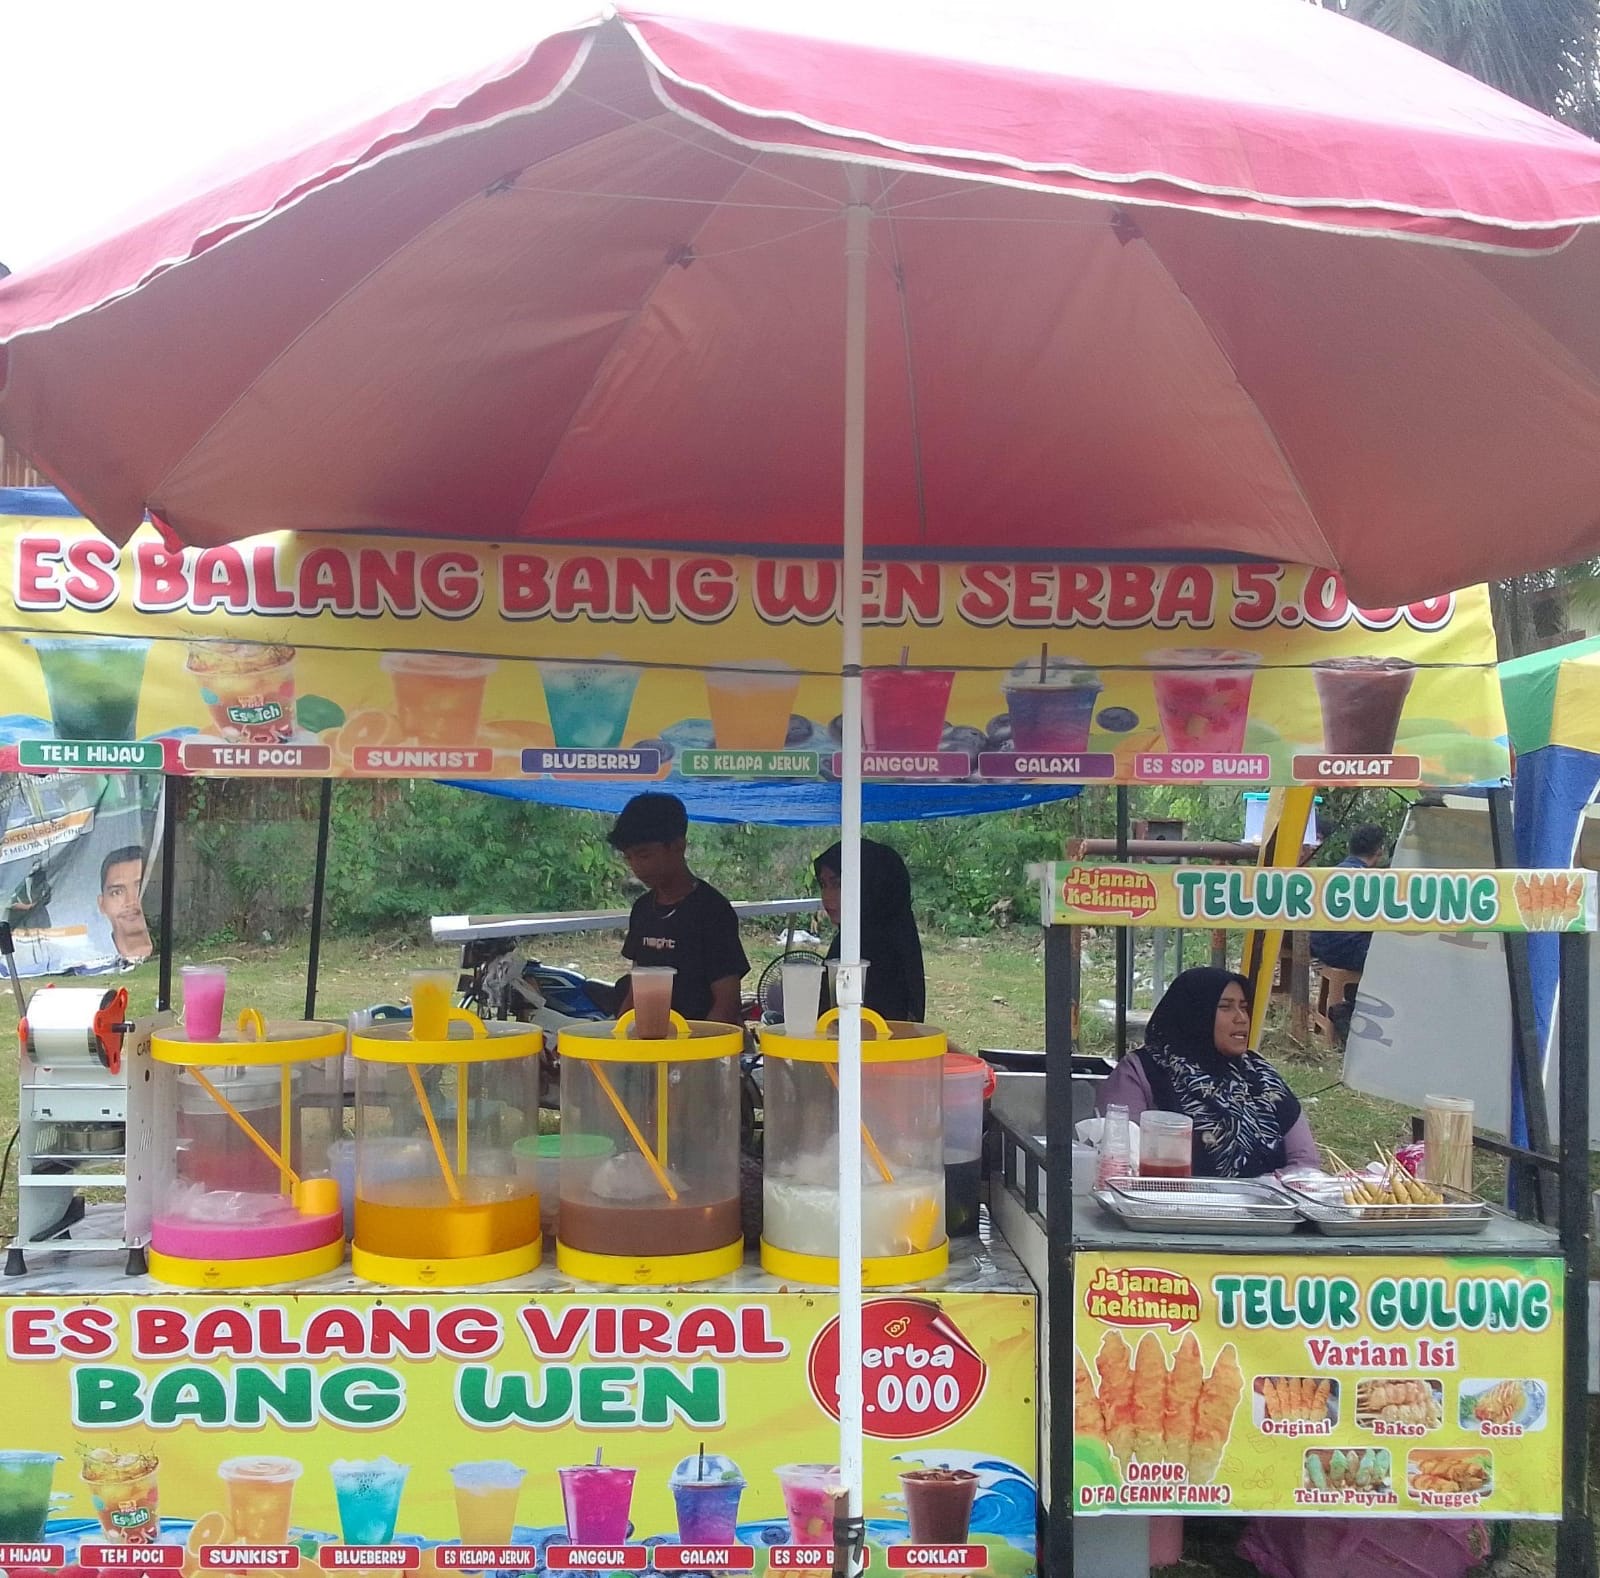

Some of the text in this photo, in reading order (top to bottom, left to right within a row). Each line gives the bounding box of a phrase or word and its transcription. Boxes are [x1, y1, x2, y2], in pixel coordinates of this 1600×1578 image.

[18, 537, 119, 607] ES
[136, 541, 484, 613] BALANG
[500, 553, 737, 620] BANG
[960, 563, 1215, 625] SERBA
[1233, 563, 1453, 627] 5.0
[40, 745, 145, 763] TEH HIJAU
[212, 748, 302, 765] TEH POCI
[367, 751, 478, 768] SUNKIST
[542, 752, 640, 770] BLUEBERRY
[693, 755, 811, 772] ES KELAPA JERUK
[863, 756, 940, 773] ANGGUR
[1014, 757, 1080, 774] GALAXI
[1143, 759, 1263, 775] ES SOP BUAH
[1318, 760, 1393, 776] COKLAT
[1067, 867, 1148, 889] Jajanan
[1066, 888, 1156, 911] Kekinian
[1175, 870, 1498, 922] TELUR GULUNG
[1092, 1269, 1190, 1296] Jajanan
[1092, 1296, 1199, 1323] Kekinian
[1213, 1278, 1550, 1331] TELUR GULUNG
[11, 1307, 785, 1356] ES BALANG VIRAL
[862, 1343, 954, 1368] erba
[1307, 1339, 1455, 1368] Varian Isi
[76, 1366, 720, 1424] BANG WEN
[836, 1374, 960, 1413] .000
[1261, 1420, 1331, 1438] Original
[1374, 1420, 1425, 1436] Bakso
[1481, 1421, 1523, 1436] Sosis
[1128, 1463, 1185, 1481] DAPUR
[1081, 1486, 1115, 1504] D'FA
[1295, 1489, 1398, 1507] Telur Puyuh
[1421, 1490, 1481, 1507] Nugget
[10, 1549, 52, 1563] HIJAU
[100, 1549, 164, 1563] TEH POCI
[209, 1550, 290, 1564] SUNKIST
[335, 1549, 407, 1564] BLUEBERRY
[445, 1549, 530, 1565] ES KELAPA JERUK
[568, 1549, 625, 1565] ANGGUR
[680, 1549, 729, 1564] GALAXI
[775, 1549, 790, 1564] ES
[796, 1549, 822, 1564] SOP
[906, 1549, 968, 1564] COKLAT
